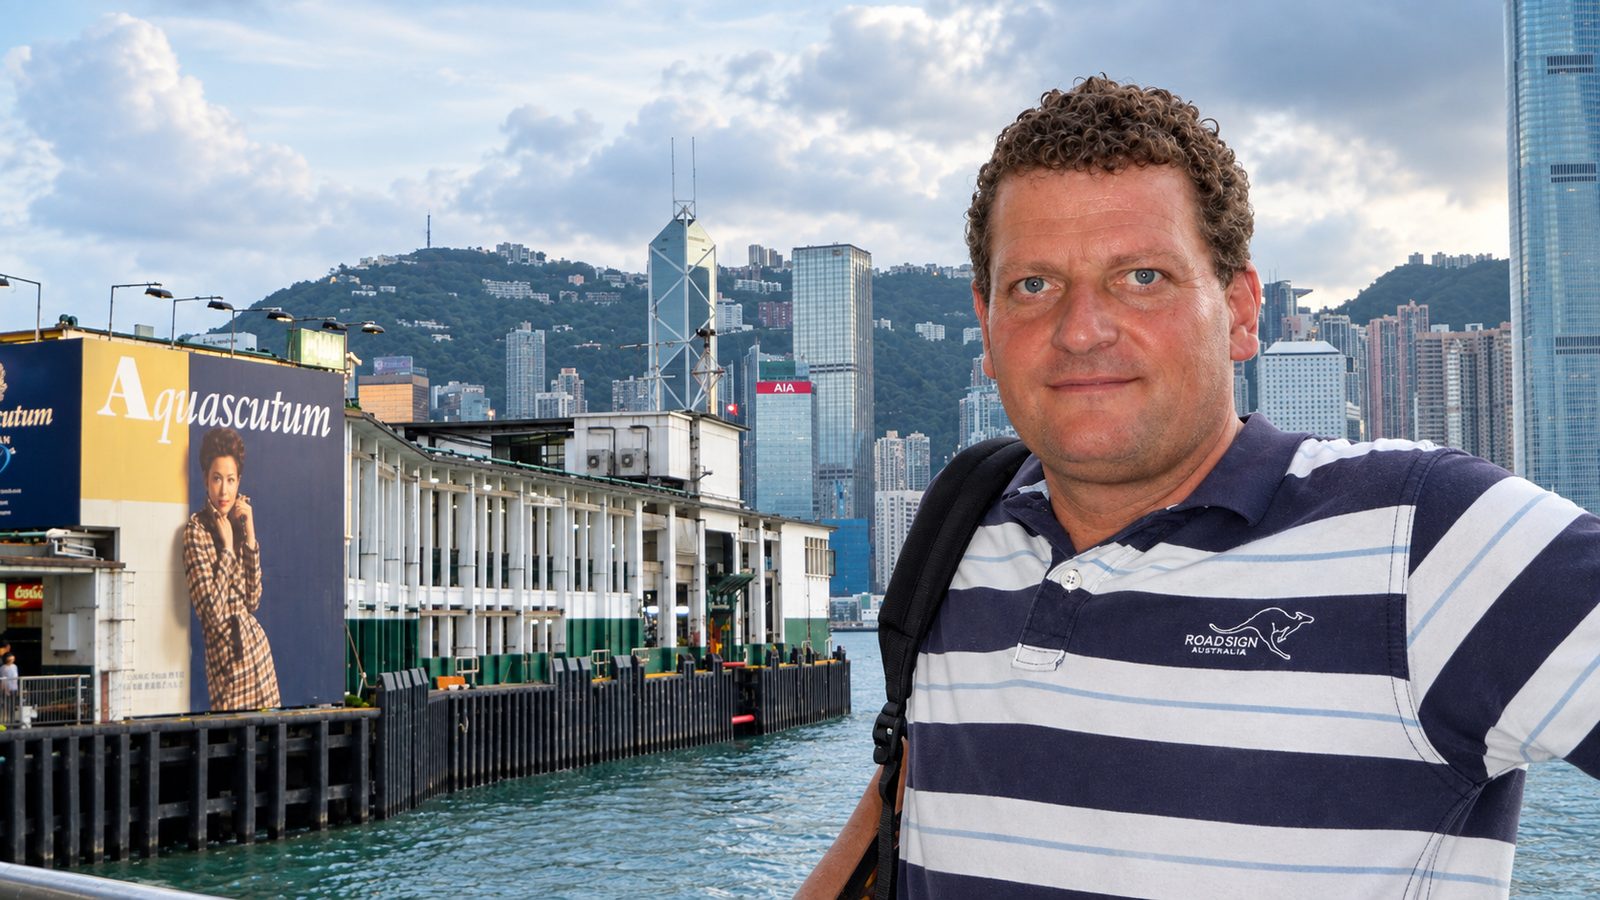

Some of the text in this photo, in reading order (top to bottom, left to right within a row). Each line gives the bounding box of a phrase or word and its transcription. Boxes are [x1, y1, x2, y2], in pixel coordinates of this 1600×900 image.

[774, 383, 795, 393] AIA
[96, 356, 331, 444] Aquascutum
[1184, 634, 1259, 648] ROADSIGN
[1191, 646, 1247, 656] AUSTRALIA
